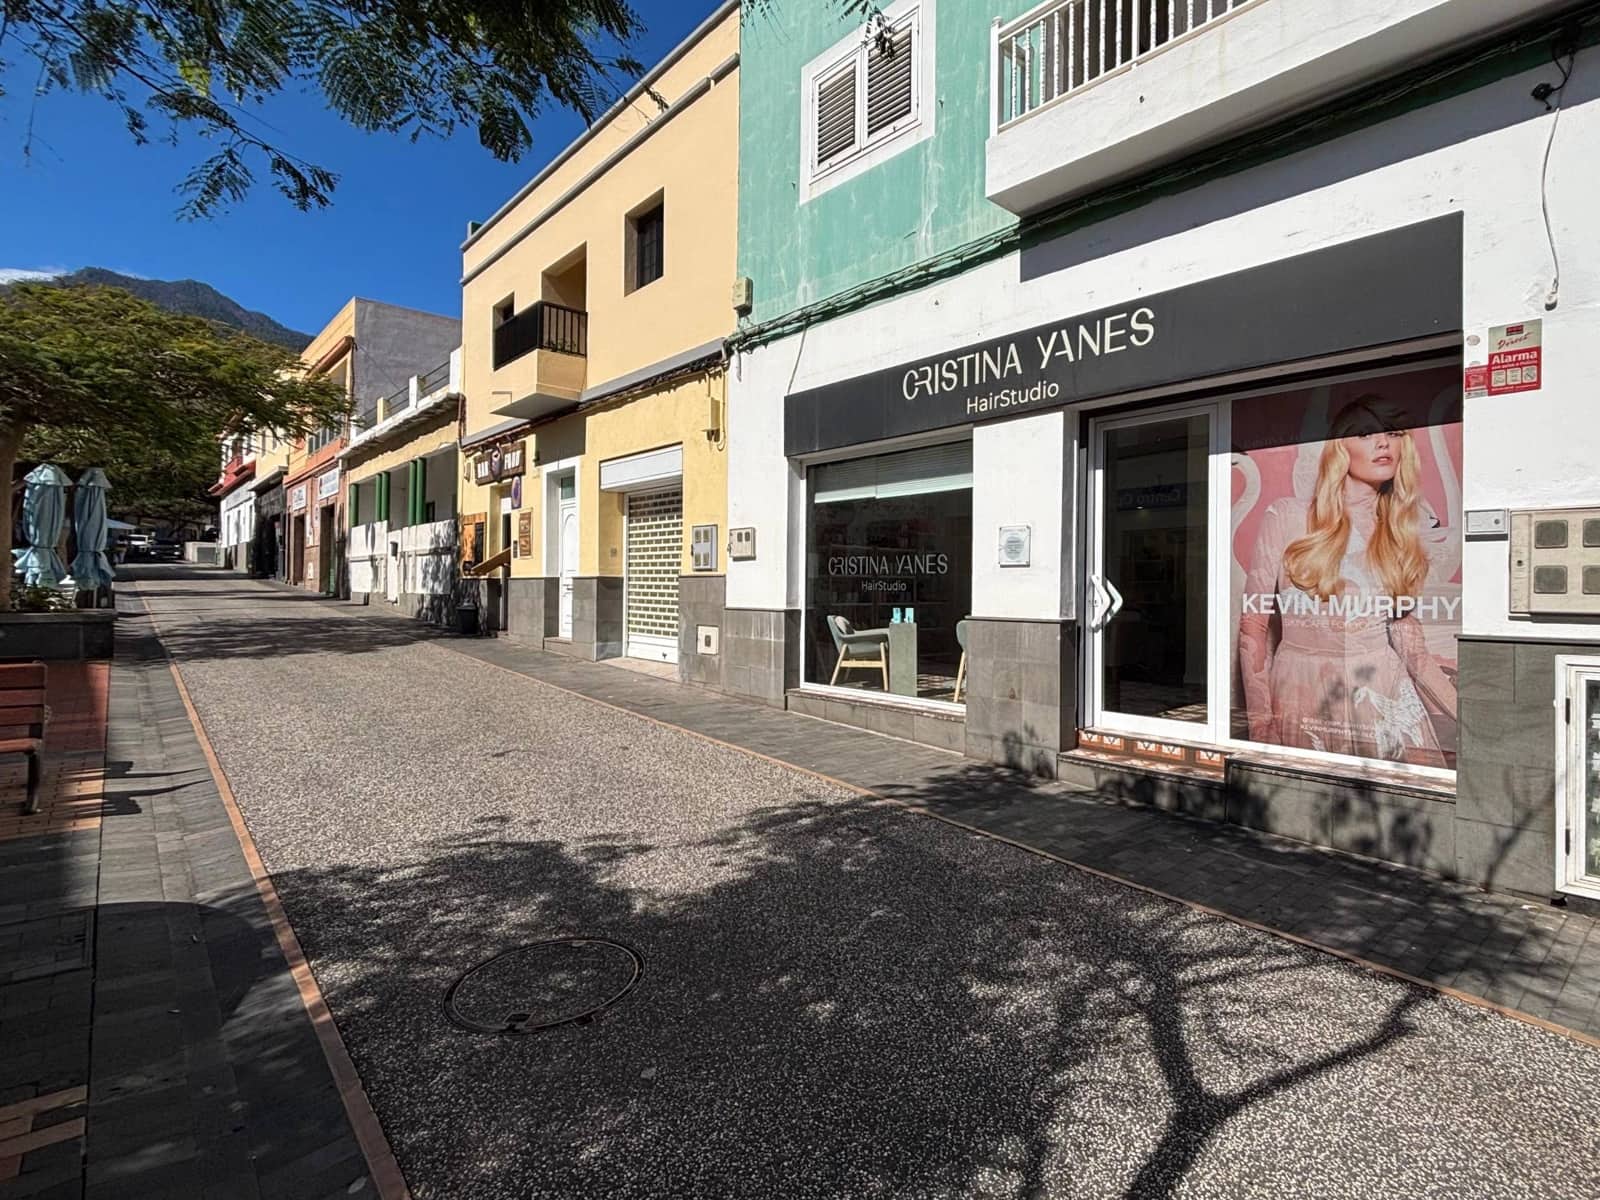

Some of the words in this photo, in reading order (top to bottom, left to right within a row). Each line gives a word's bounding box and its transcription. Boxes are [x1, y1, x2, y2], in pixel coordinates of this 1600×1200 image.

[903, 342, 1023, 400] CRISTINA
[1037, 307, 1155, 369] YANES
[1492, 351, 1537, 365] Alarma
[966, 380, 1060, 415] HairStudio
[828, 555, 889, 576] CRISTINA
[896, 554, 949, 575] YANES
[861, 580, 907, 593] HairStudio
[1242, 593, 1461, 620] KEVIN.MURPHY
